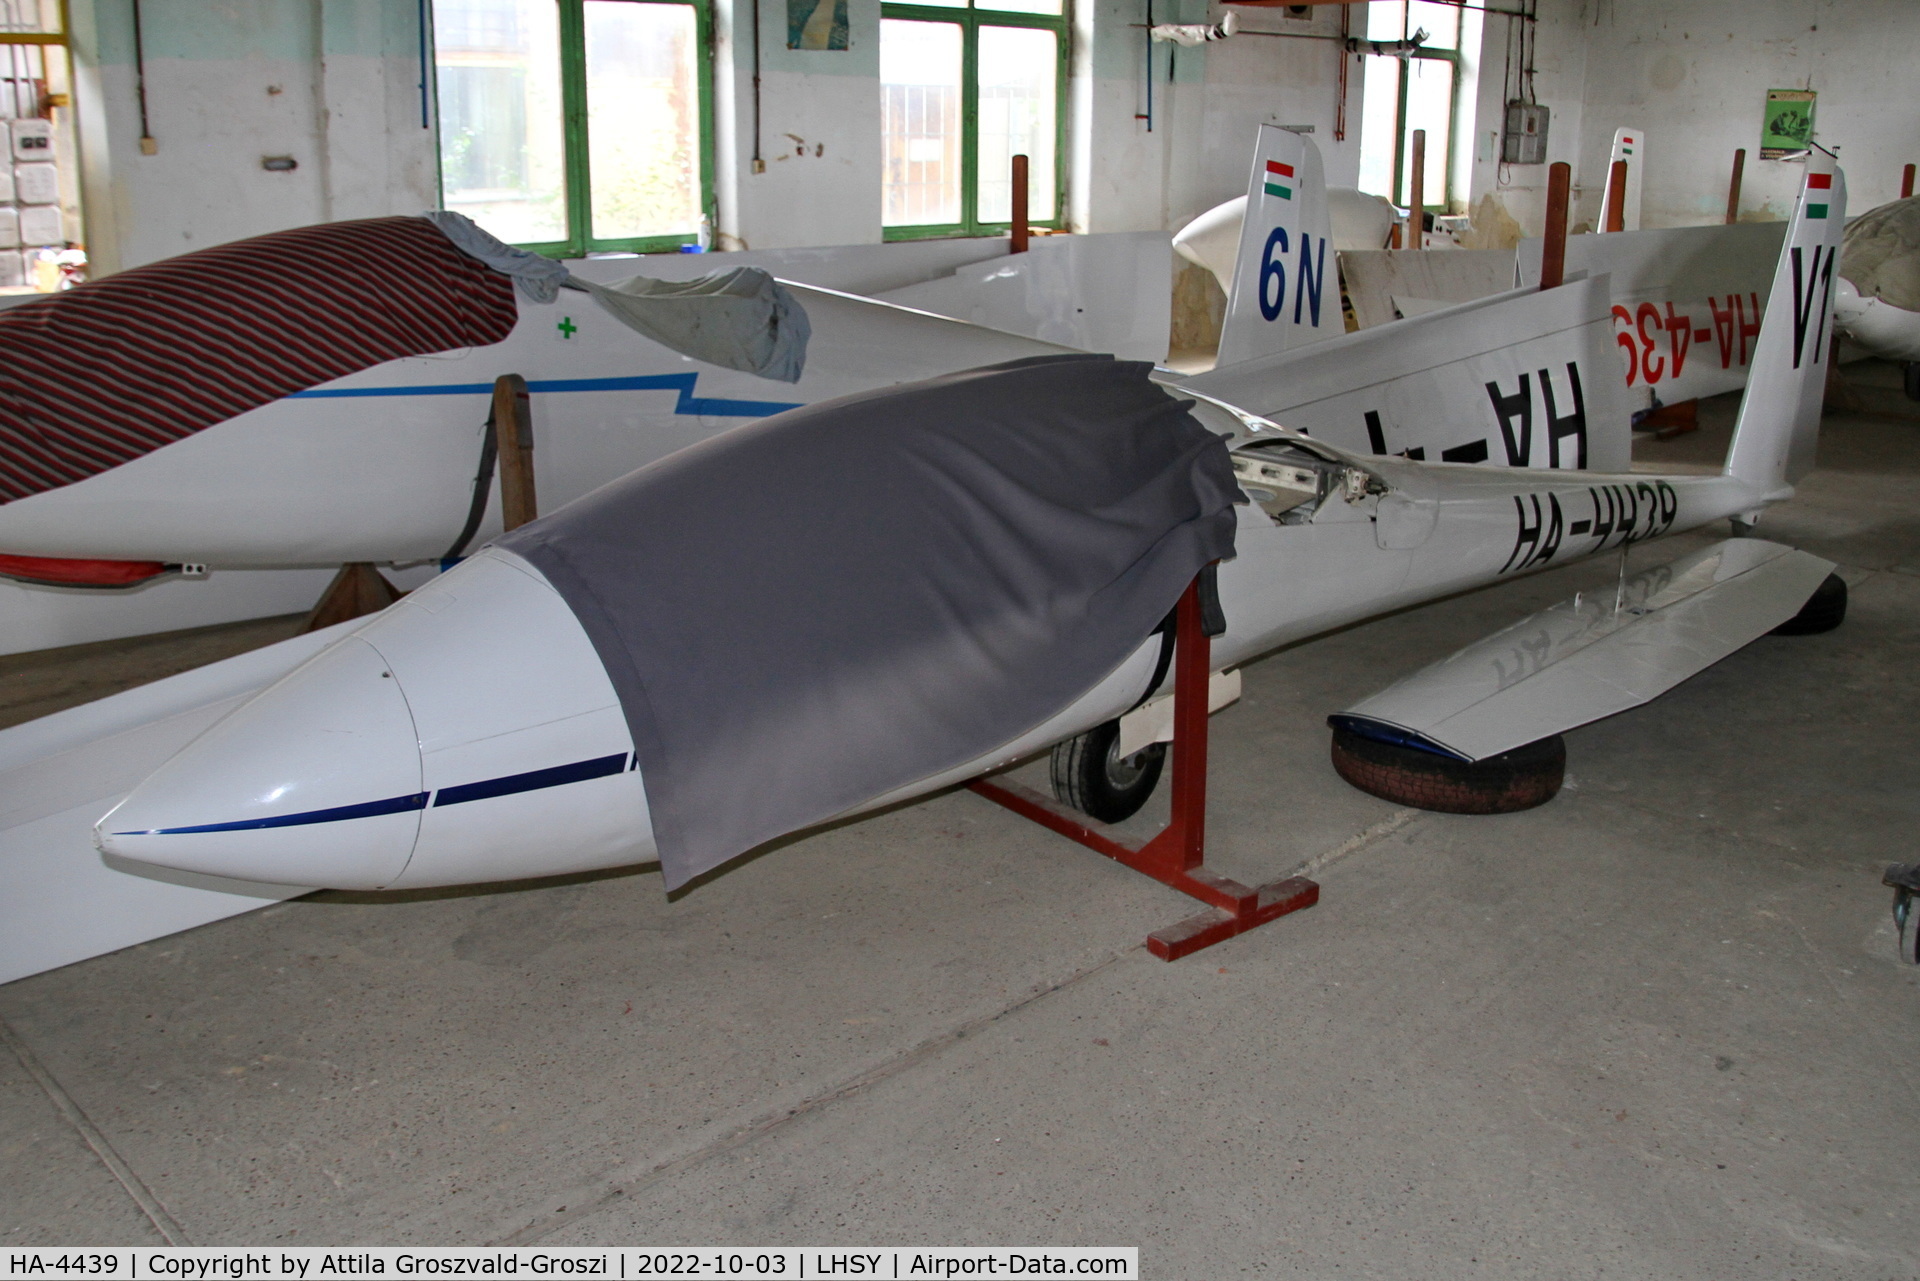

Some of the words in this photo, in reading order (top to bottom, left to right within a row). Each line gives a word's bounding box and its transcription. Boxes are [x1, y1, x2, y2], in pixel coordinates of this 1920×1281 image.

[1259, 226, 1326, 328] 6N
[1791, 245, 1835, 370] V1
[1498, 480, 1677, 575] HA-4439
